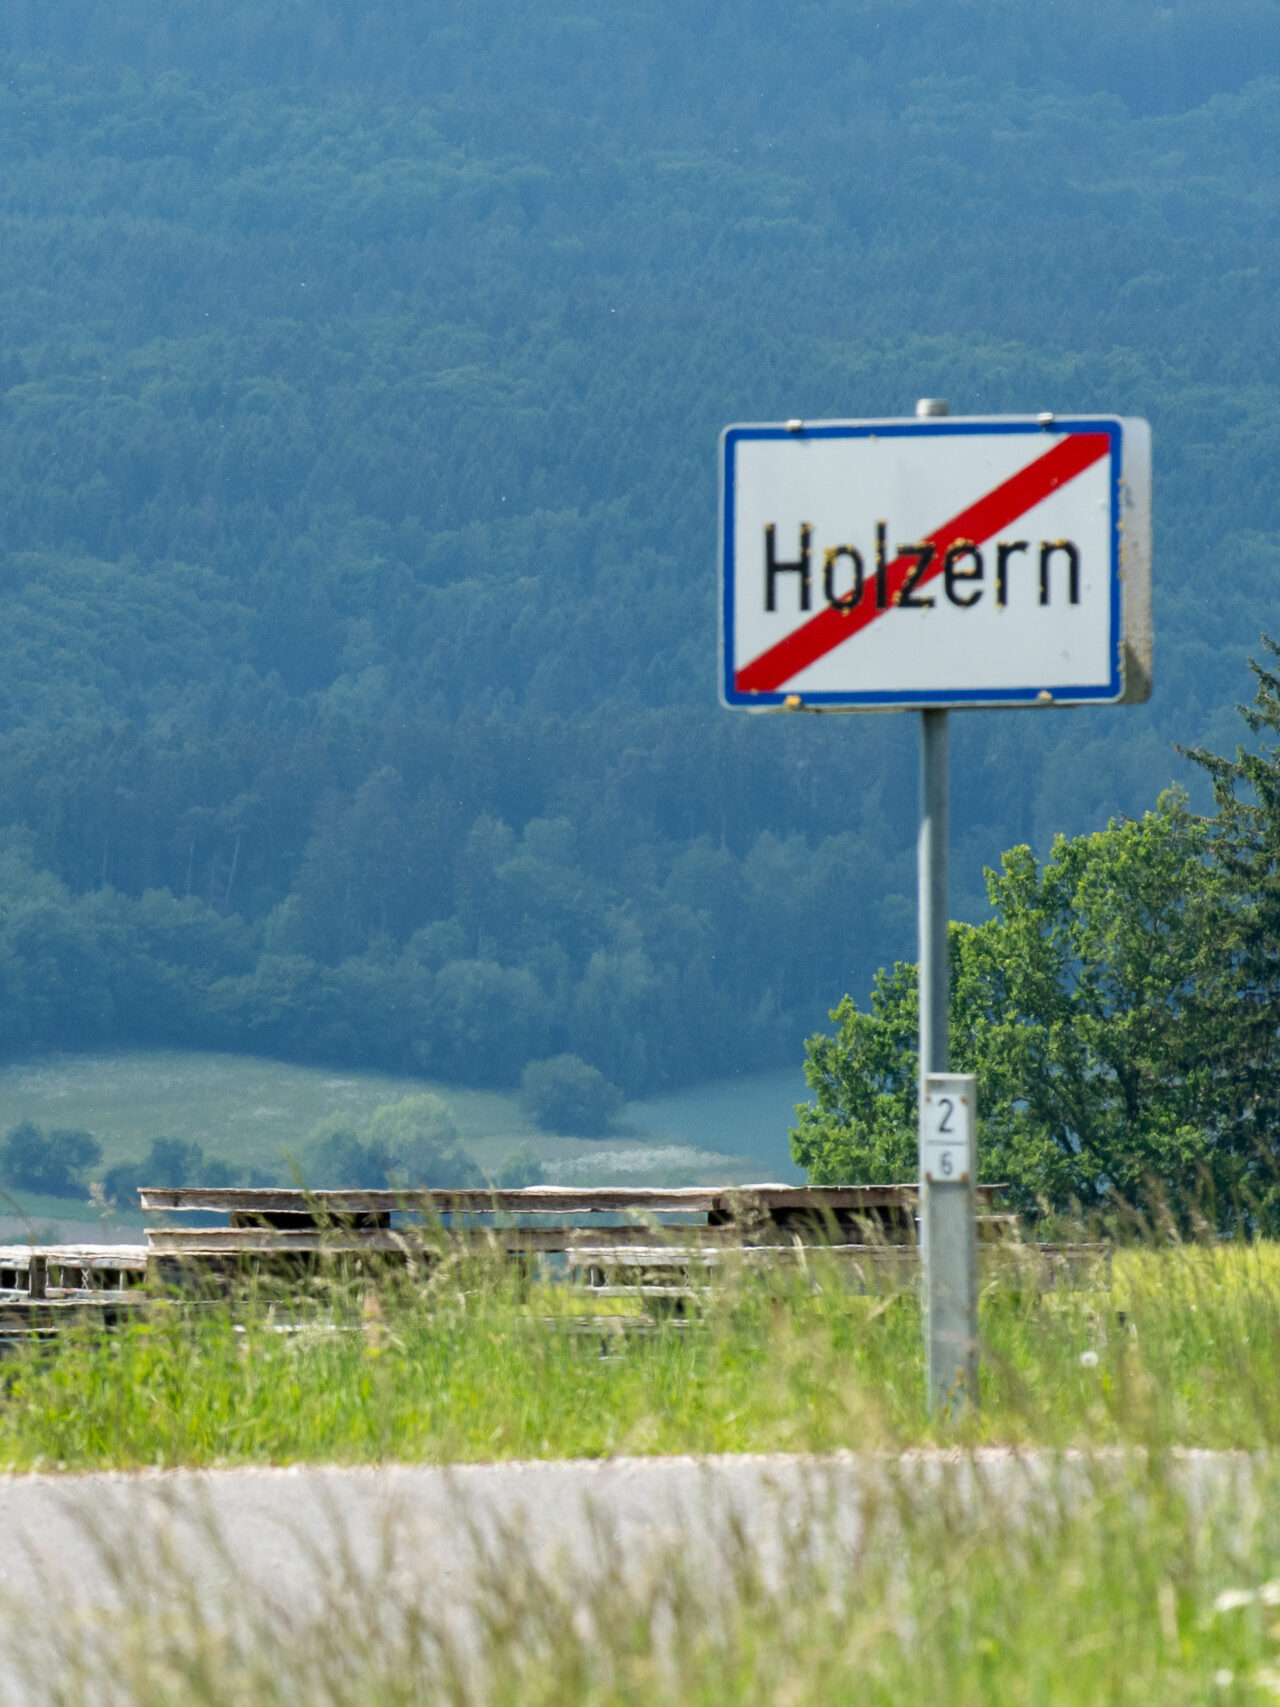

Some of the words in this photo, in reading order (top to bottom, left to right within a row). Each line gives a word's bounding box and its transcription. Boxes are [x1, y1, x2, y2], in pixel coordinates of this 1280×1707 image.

[764, 519, 1080, 614] Holzern
[938, 1098, 955, 1134] 2
[940, 1150, 954, 1176] 6
